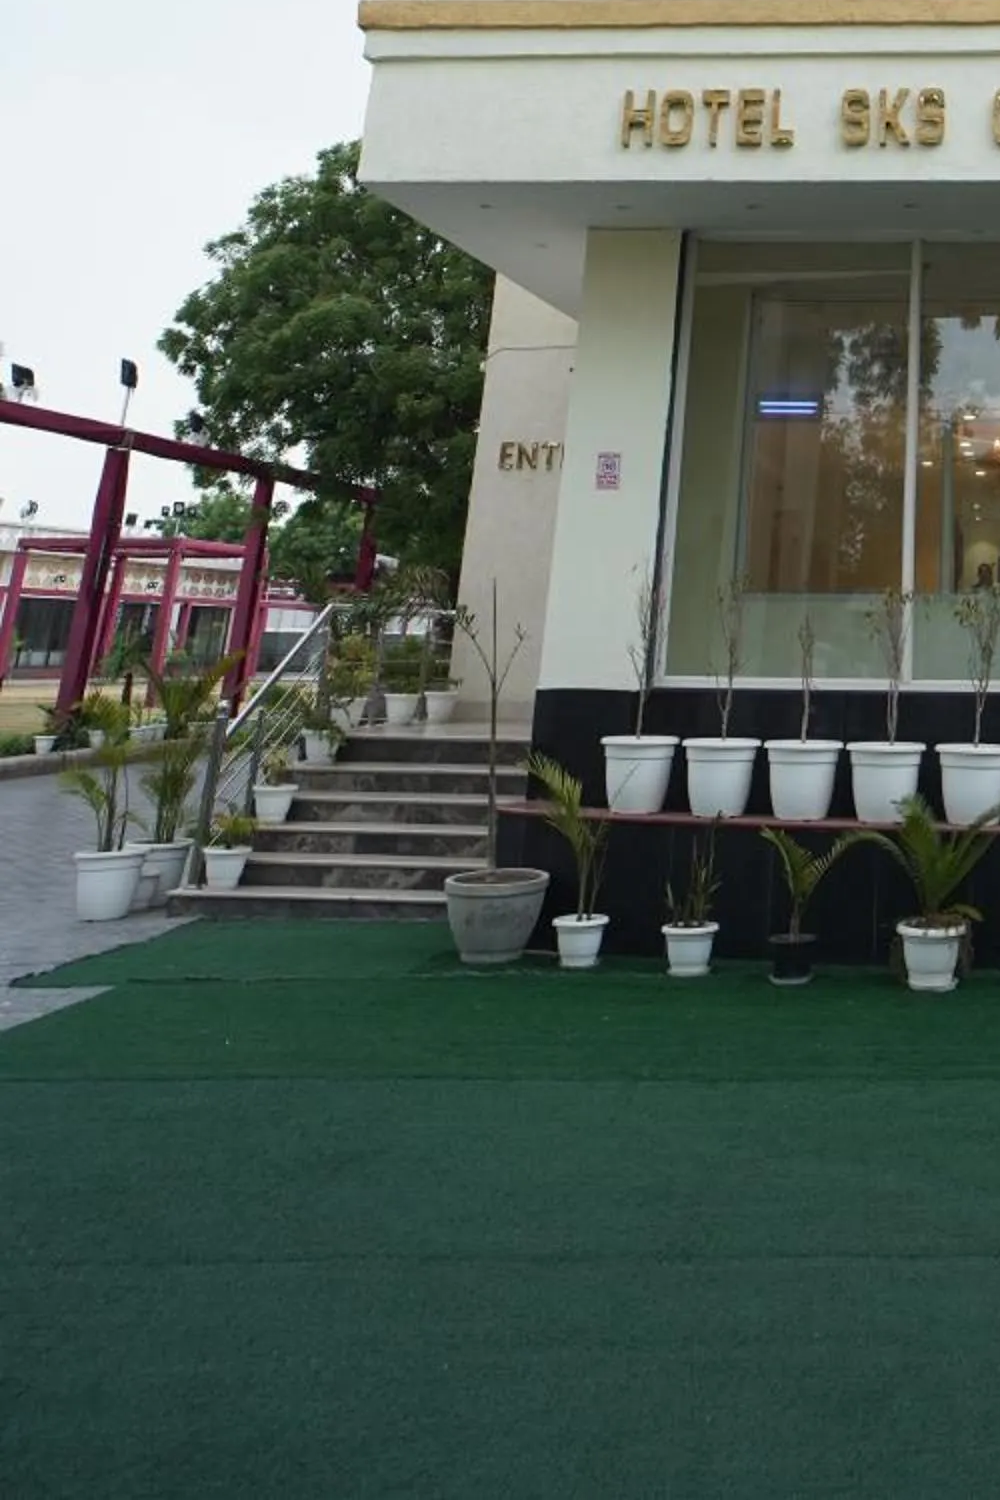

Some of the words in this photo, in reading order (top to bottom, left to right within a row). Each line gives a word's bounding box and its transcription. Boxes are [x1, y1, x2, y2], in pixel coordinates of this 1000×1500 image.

[621, 88, 795, 148] HOTEL
[839, 88, 946, 148] SKS
[498, 441, 565, 471] ENT
